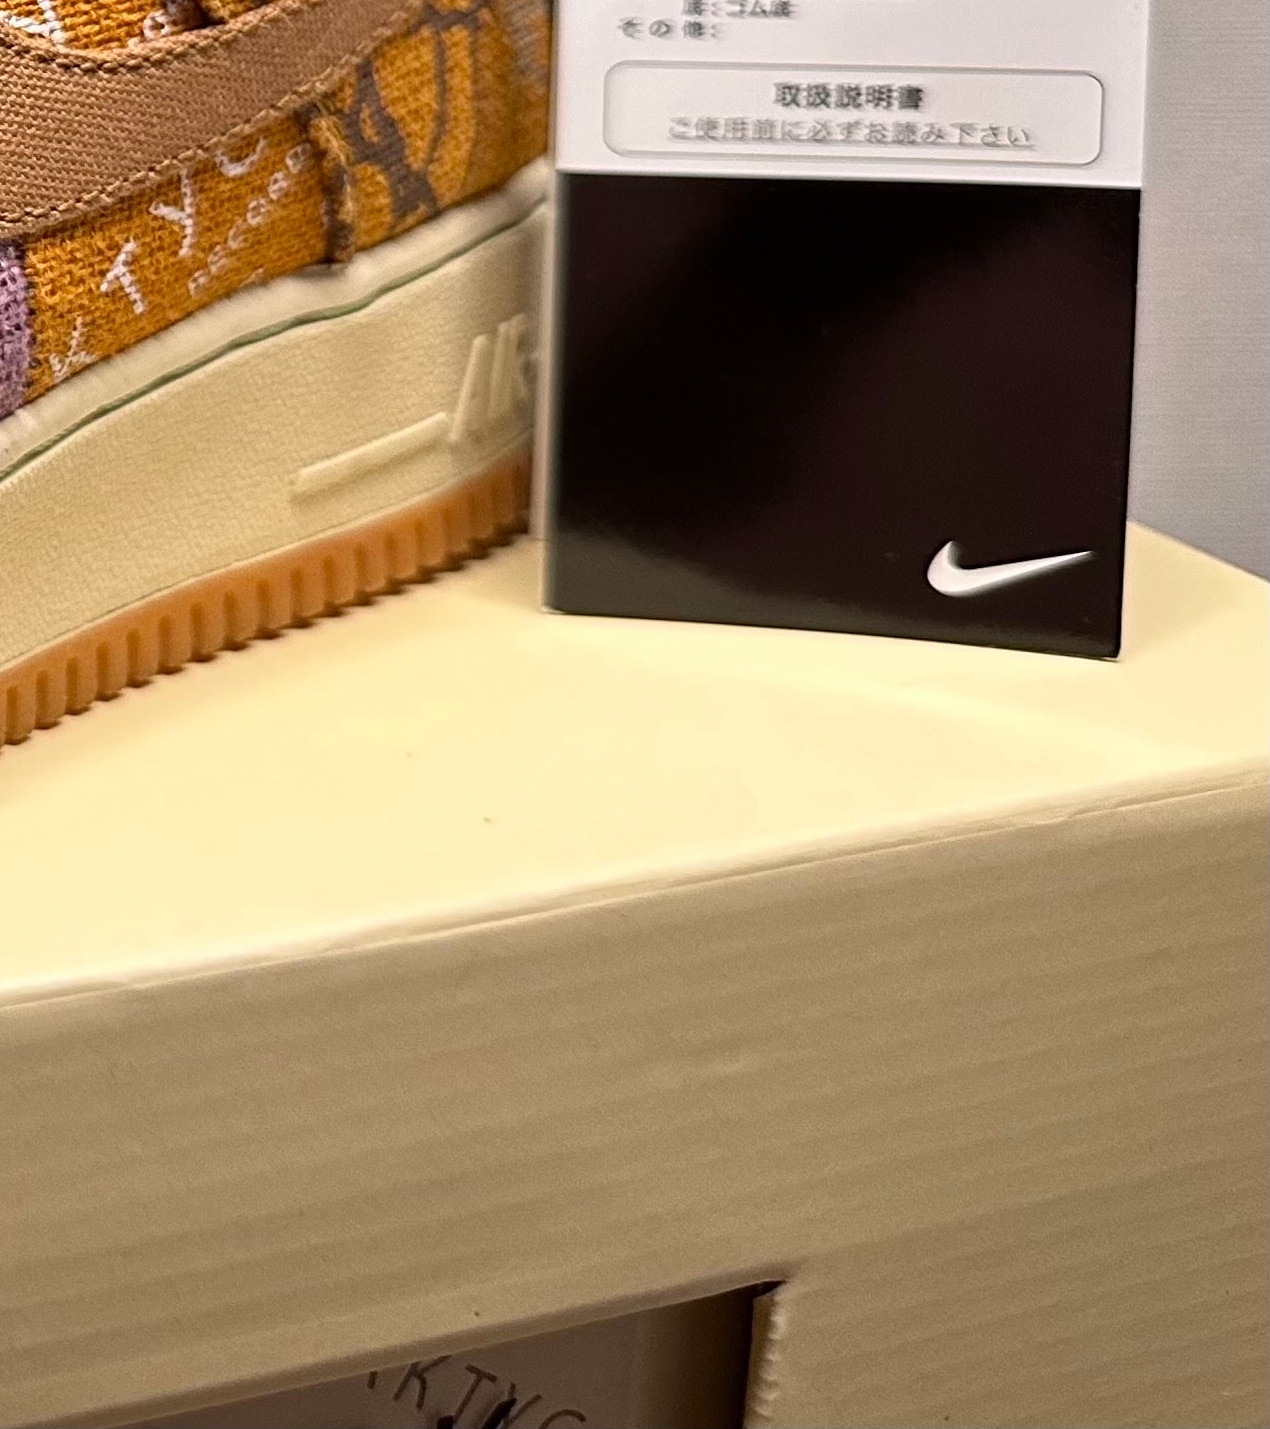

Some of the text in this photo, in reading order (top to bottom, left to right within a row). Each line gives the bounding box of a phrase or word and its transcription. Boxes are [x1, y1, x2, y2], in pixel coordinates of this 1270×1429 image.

[774, 82, 925, 111] 取扱説明書
